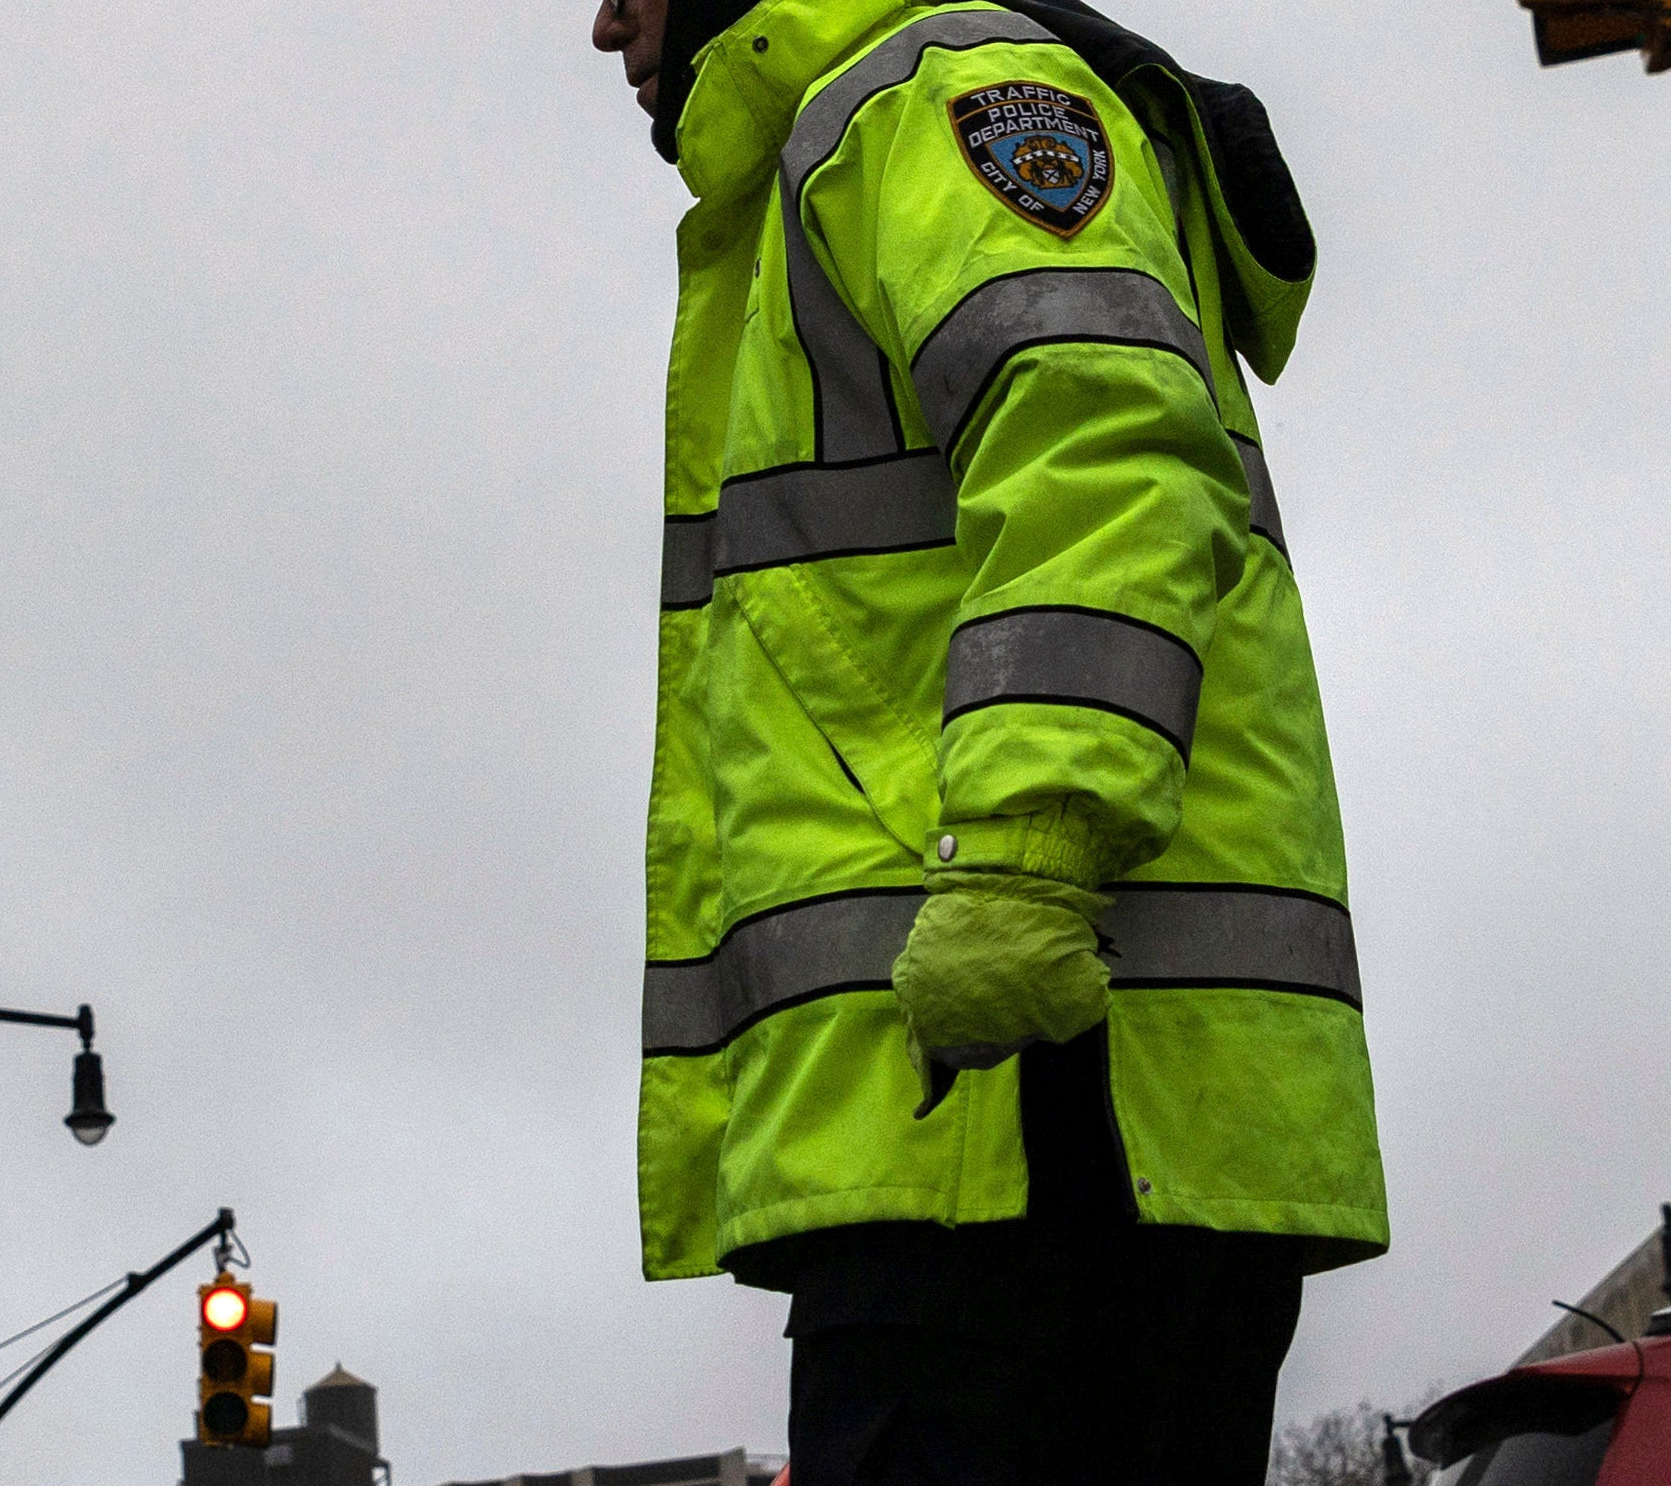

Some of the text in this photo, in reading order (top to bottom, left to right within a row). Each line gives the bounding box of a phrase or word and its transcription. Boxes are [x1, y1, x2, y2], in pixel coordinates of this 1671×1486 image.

[970, 86, 1071, 106] TRAFFIC
[988, 103, 1066, 121] POLICE
[968, 117, 1099, 148] DEPARTMENT
[980, 149, 1106, 216] CITY OF NEW YORK
